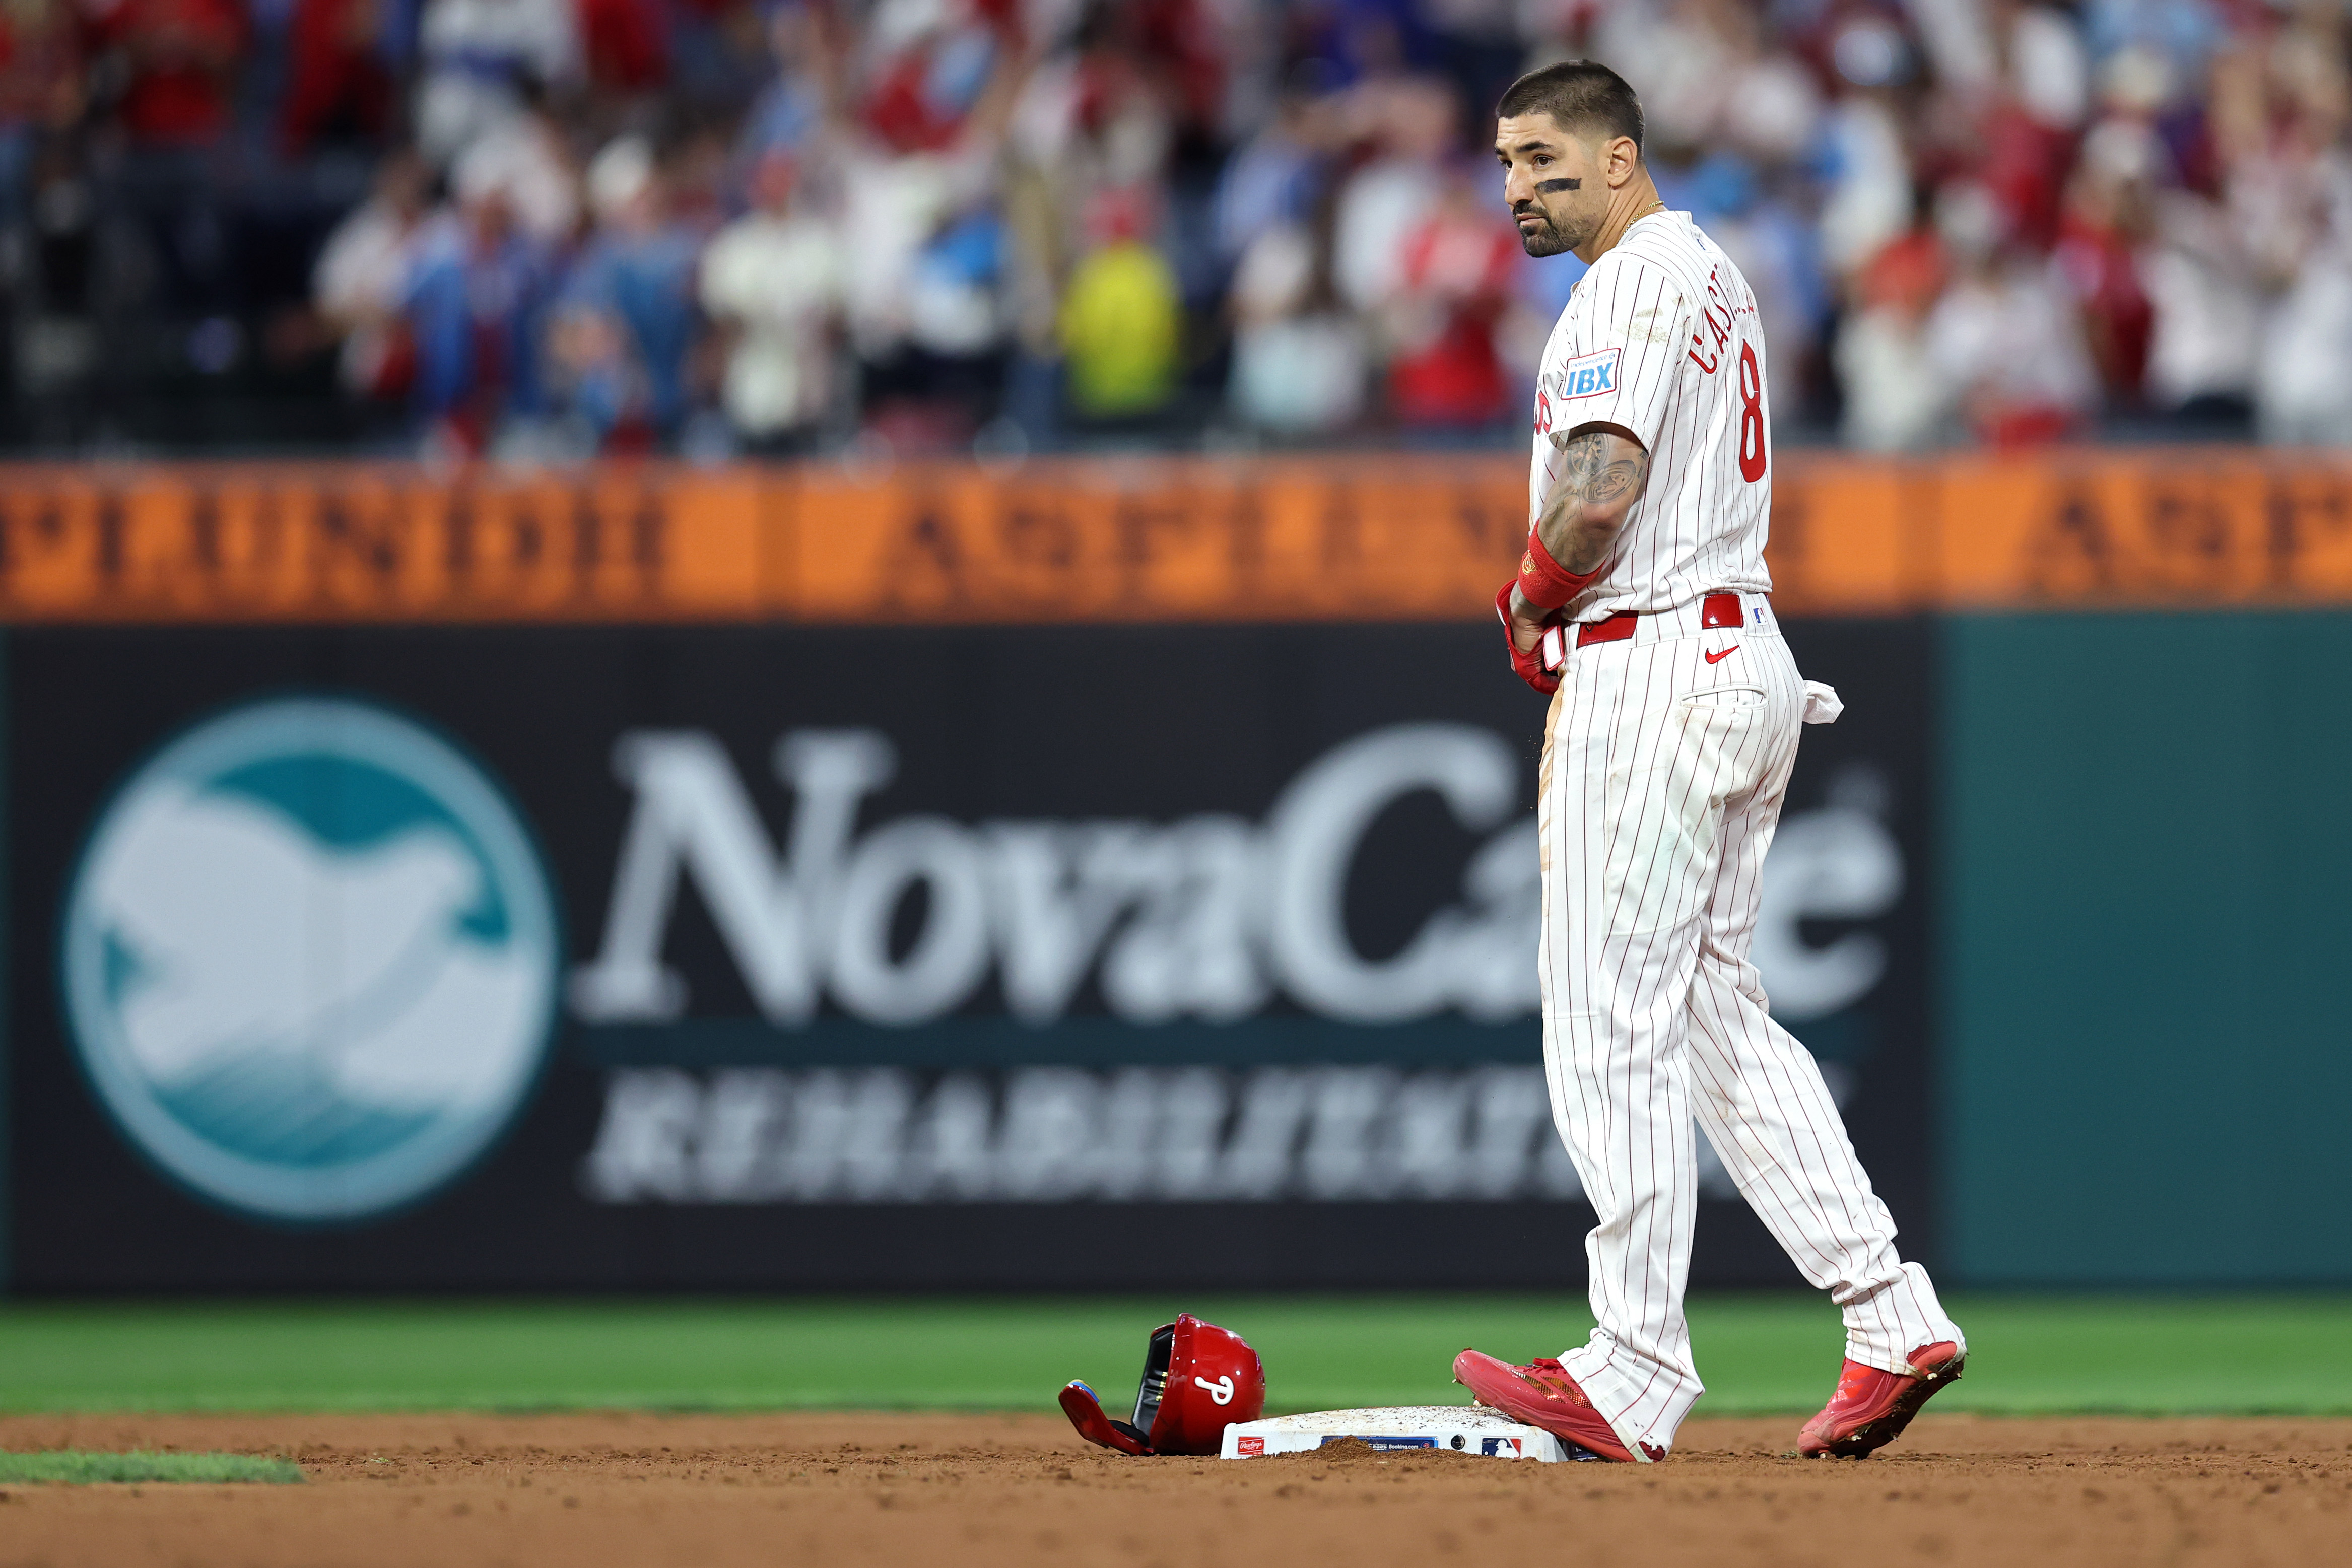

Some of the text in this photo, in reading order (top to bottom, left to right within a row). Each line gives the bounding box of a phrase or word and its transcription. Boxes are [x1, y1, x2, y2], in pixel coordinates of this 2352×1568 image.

[1571, 355, 1607, 368] Independence
[1566, 362, 1613, 396] IBX
[1739, 338, 1766, 483] 8
[571, 724, 1903, 1025] NovaCae
[1194, 1375, 1235, 1406] P
[1239, 1441, 1262, 1450] Rawlings
